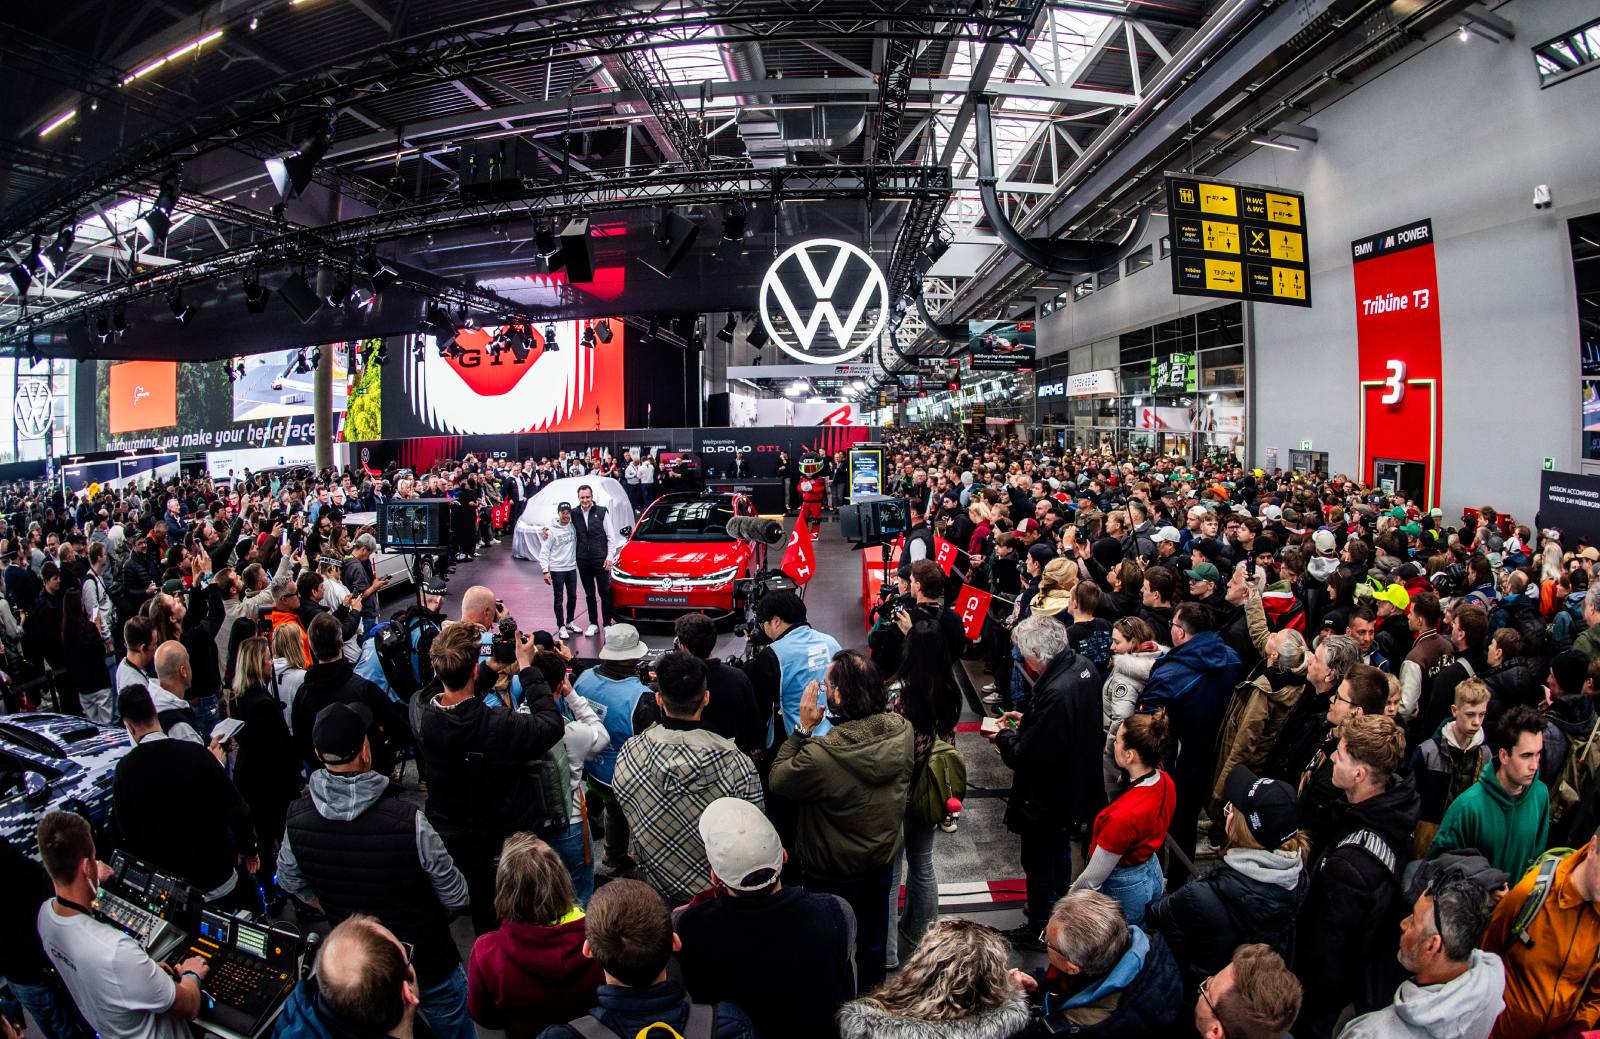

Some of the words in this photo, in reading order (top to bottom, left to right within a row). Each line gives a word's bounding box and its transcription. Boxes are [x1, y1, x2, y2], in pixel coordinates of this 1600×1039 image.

[1252, 197, 1264, 205] WC
[1252, 205, 1265, 213] WC
[1354, 241, 1373, 257] BMW
[1397, 226, 1429, 244] POWER
[1363, 293, 1408, 315] Tribüne
[1412, 288, 1430, 309] T3
[459, 349, 525, 368] GT
[1381, 359, 1406, 404] 3
[1044, 382, 1064, 396] AMG
[163, 435, 179, 449] we
[181, 431, 212, 449] make
[215, 428, 243, 448] your
[246, 421, 285, 442] heart
[756, 445, 781, 453] GTI
[1548, 494, 1565, 503] WINNER
[1549, 485, 1567, 493] MISSION
[1567, 488, 1599, 499] ACCOMPLISHED
